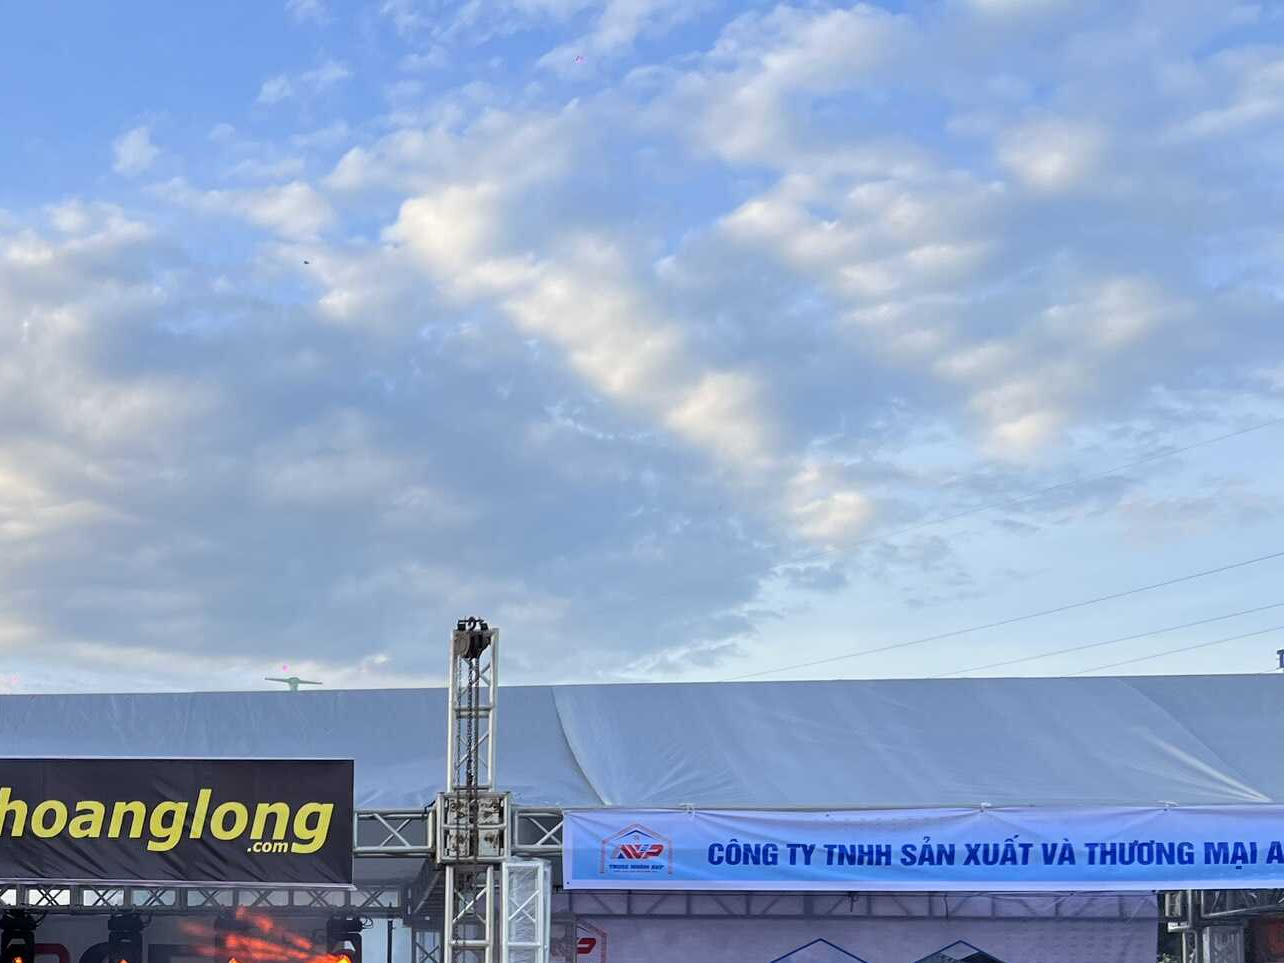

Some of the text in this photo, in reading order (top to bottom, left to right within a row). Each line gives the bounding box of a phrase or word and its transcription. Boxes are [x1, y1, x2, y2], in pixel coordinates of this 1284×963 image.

[246, 840, 289, 854] .com
[707, 838, 778, 866] CÔNG
[786, 843, 816, 866] TY
[824, 844, 892, 866] TNHH
[900, 836, 955, 866] SẢN
[963, 834, 1033, 866] XUẤT
[1041, 837, 1076, 866] VÀ
[1084, 839, 1194, 866] THƯƠNG
[1204, 841, 1257, 870] MẠI
